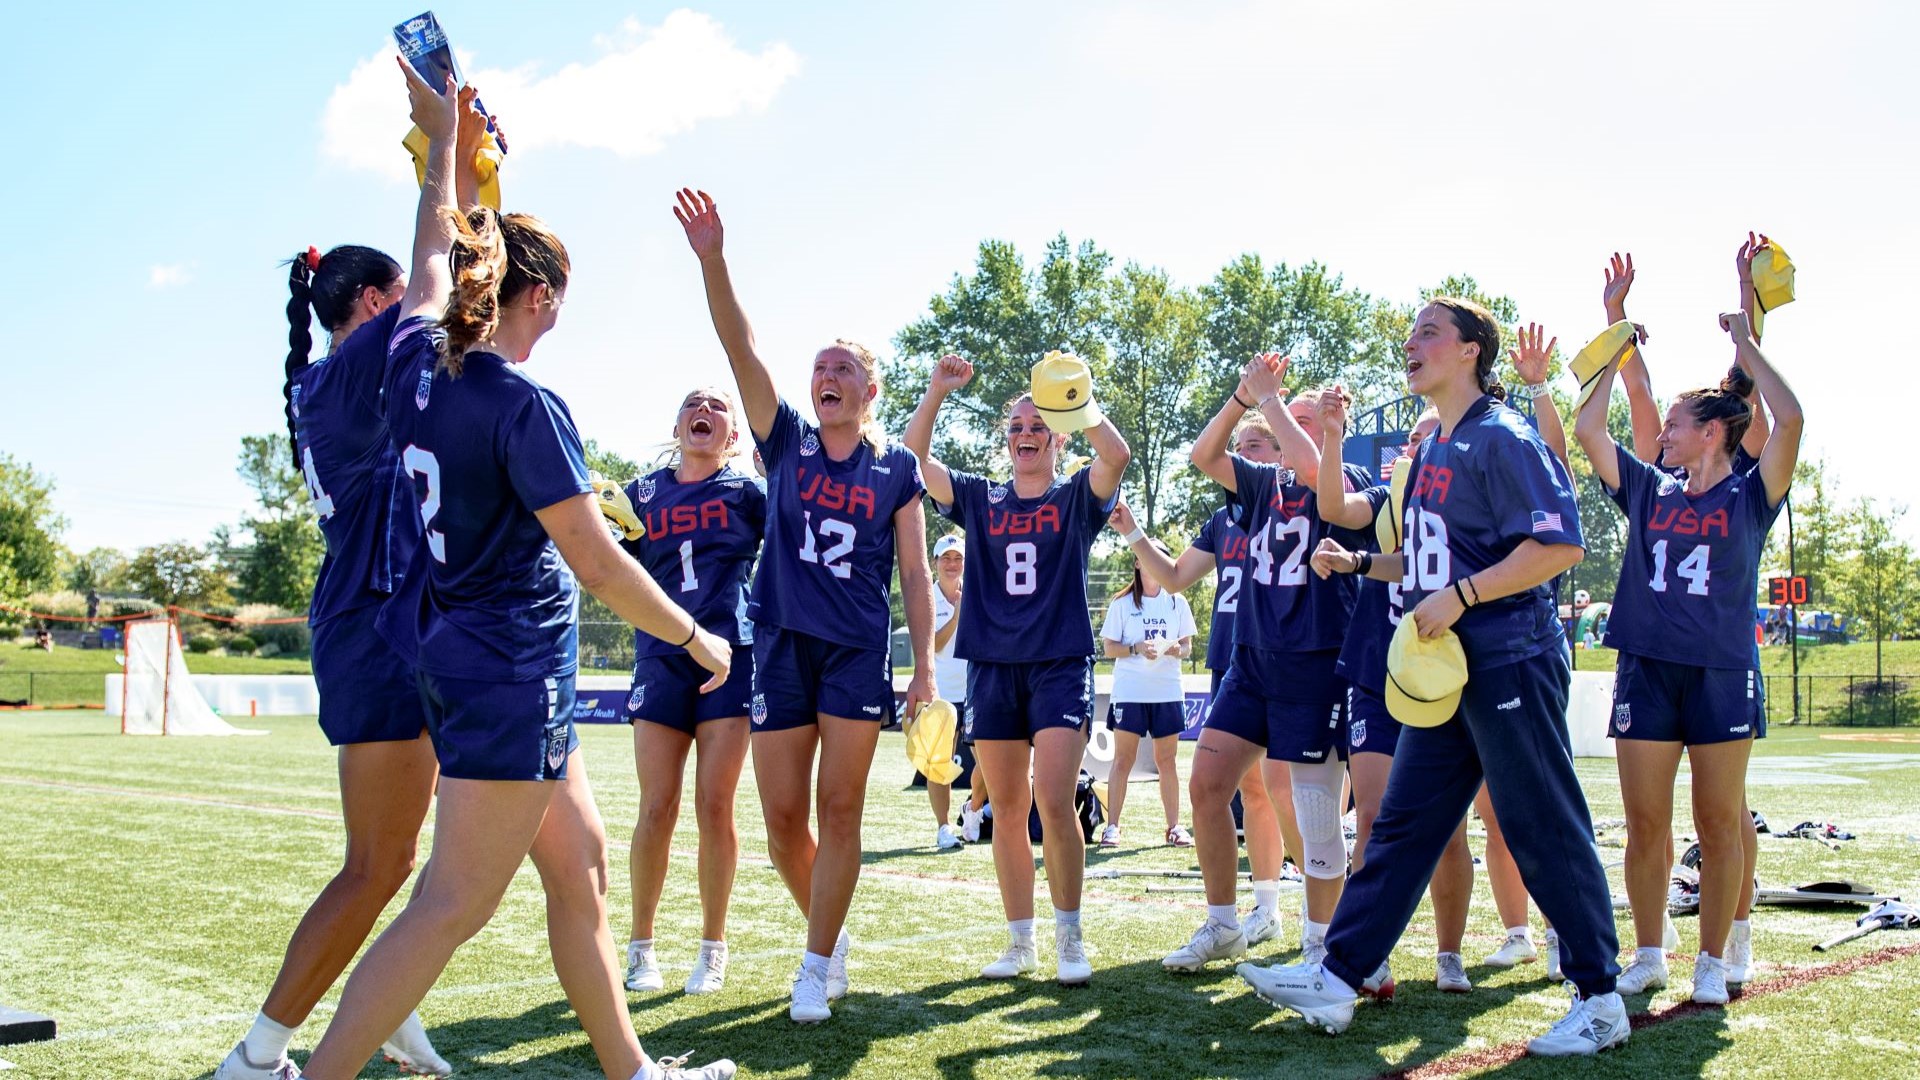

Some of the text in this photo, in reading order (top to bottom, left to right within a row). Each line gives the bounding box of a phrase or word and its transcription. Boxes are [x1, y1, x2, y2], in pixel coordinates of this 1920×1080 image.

[646, 498, 728, 541] USA
[797, 467, 875, 520] USA
[988, 504, 1060, 536] USA
[1648, 503, 1729, 537] USA
[678, 540, 699, 593] 1
[799, 510, 857, 580] 12
[1005, 542, 1037, 595] 8
[1250, 515, 1311, 586] 42
[1648, 539, 1711, 596] 14
[1773, 576, 1807, 605] 30
